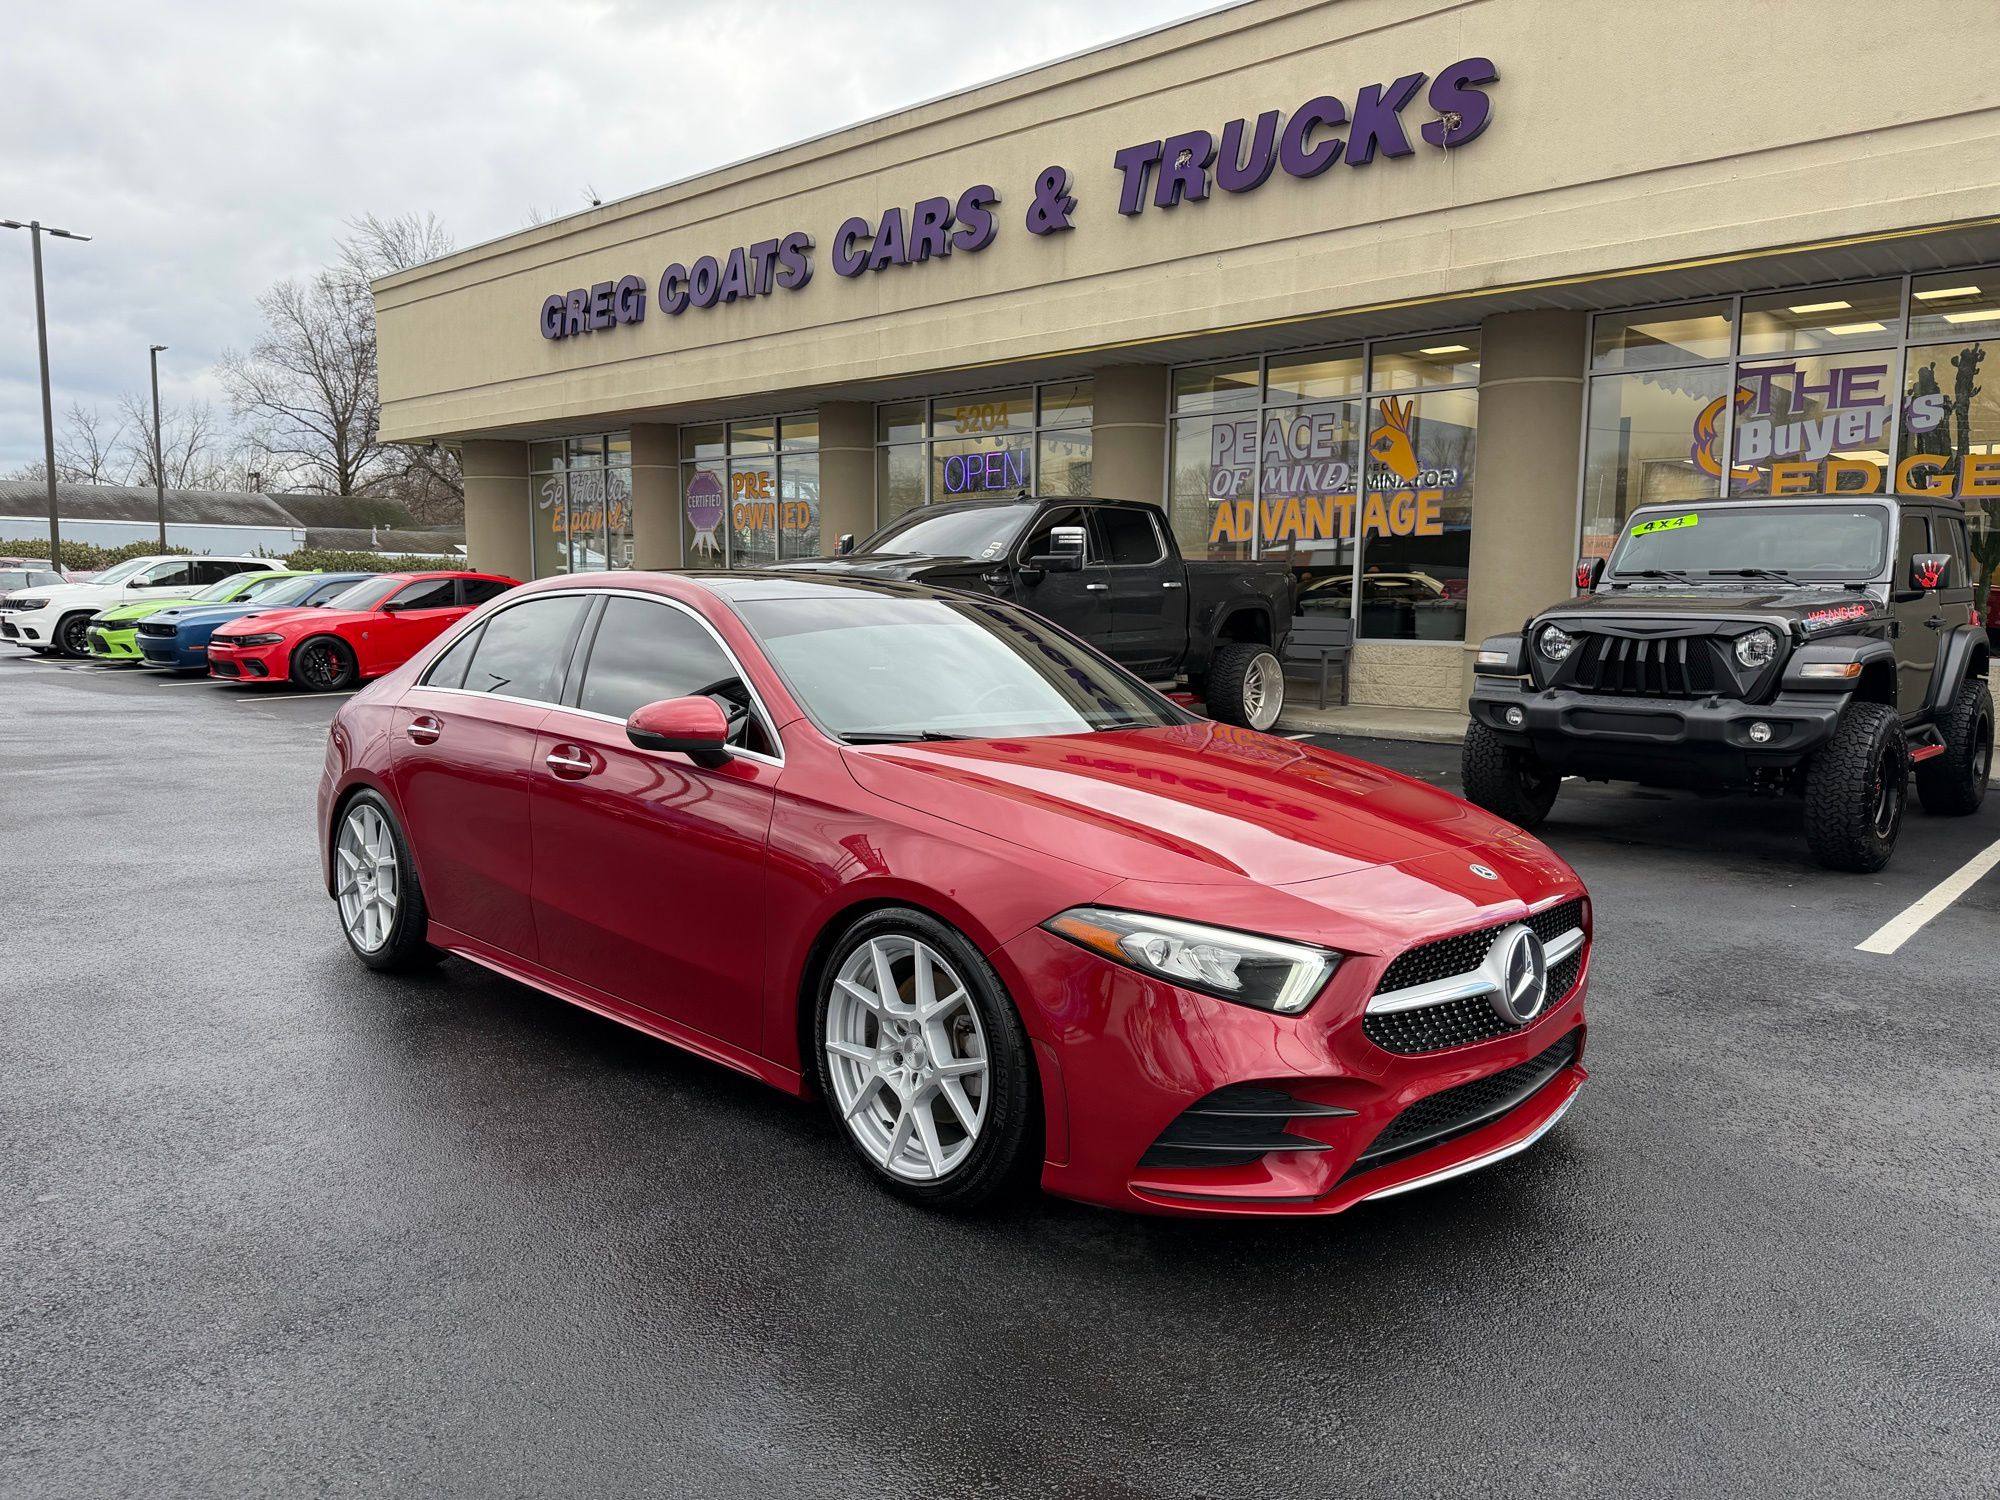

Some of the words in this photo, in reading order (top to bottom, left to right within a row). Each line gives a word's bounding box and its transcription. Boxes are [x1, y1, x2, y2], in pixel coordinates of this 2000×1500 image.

[541, 274, 646, 339] GREG
[659, 232, 815, 315] COATS
[832, 184, 1001, 277] CARS
[1025, 166, 1077, 236] &
[1114, 57, 1500, 216] TRUCKS
[1738, 362, 1888, 417] THE
[955, 402, 1008, 433] 5204
[1211, 413, 1335, 465] PEACE
[732, 471, 775, 500] PRE-
[945, 450, 1023, 492] OPEN
[1211, 470, 1249, 496] OF
[1261, 463, 1349, 493] MIND
[1771, 453, 2000, 498] EDGE
[540, 478, 563, 510] Se
[688, 494, 721, 508] CERTIFIED
[733, 501, 811, 531] OWNED
[1208, 489, 1443, 543] ADVANTAGE
[1808, 605, 1868, 621] WRANGLER
